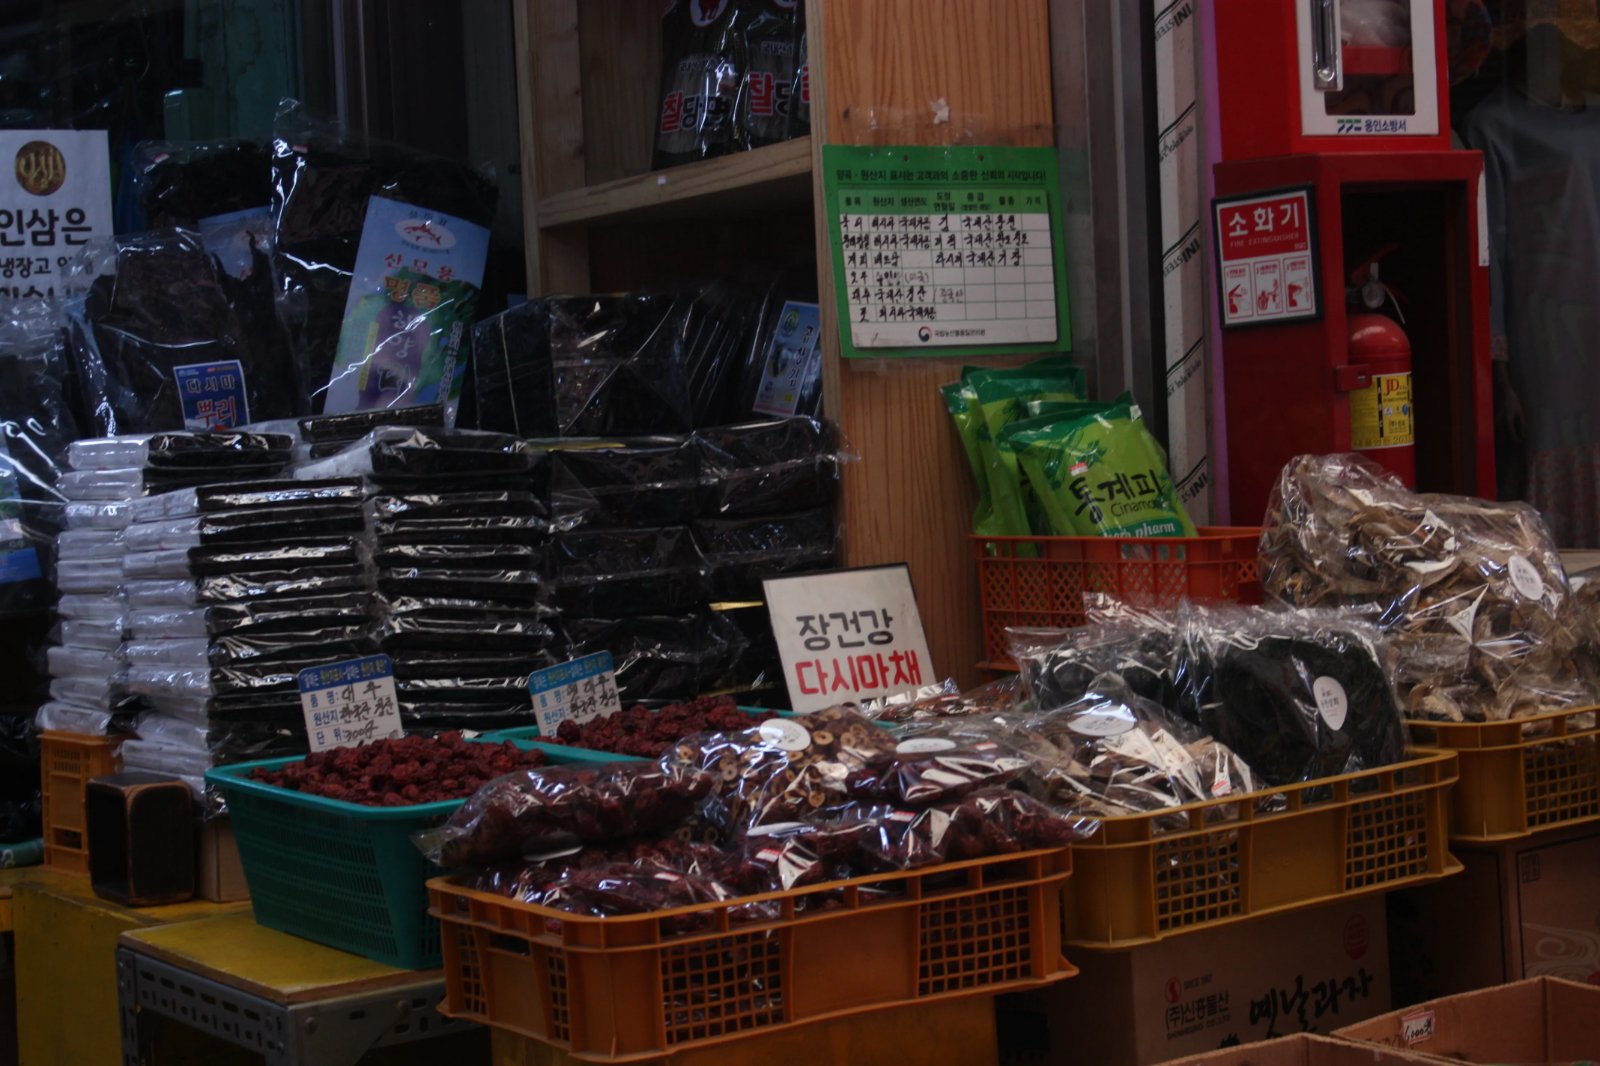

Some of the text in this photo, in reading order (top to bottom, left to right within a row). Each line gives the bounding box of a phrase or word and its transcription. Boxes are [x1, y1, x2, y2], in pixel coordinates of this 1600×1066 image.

[1364, 119, 1407, 132] 용인소방서
[861, 170, 886, 181] 원산지
[890, 170, 914, 181] 표시는
[917, 170, 949, 181] 고객과의
[952, 170, 977, 181] 소중한
[0, 208, 92, 246] 인삼은
[962, 214, 993, 231] 국내산
[1228, 202, 1300, 238] 소화기
[964, 232, 994, 249] 국내산
[0, 256, 51, 278] 냉장고
[935, 251, 962, 267] 다시마
[966, 250, 996, 267] 국내산
[186, 374, 236, 394] 다시마
[195, 395, 237, 431] 뿌리
[1069, 469, 1164, 524] 통계피
[1135, 522, 1176, 539] pharm
[796, 608, 894, 651] 장건강
[795, 649, 922, 695] 다시마채
[314, 709, 339, 727] 원산지
[1249, 967, 1374, 1039] 옛날과자
